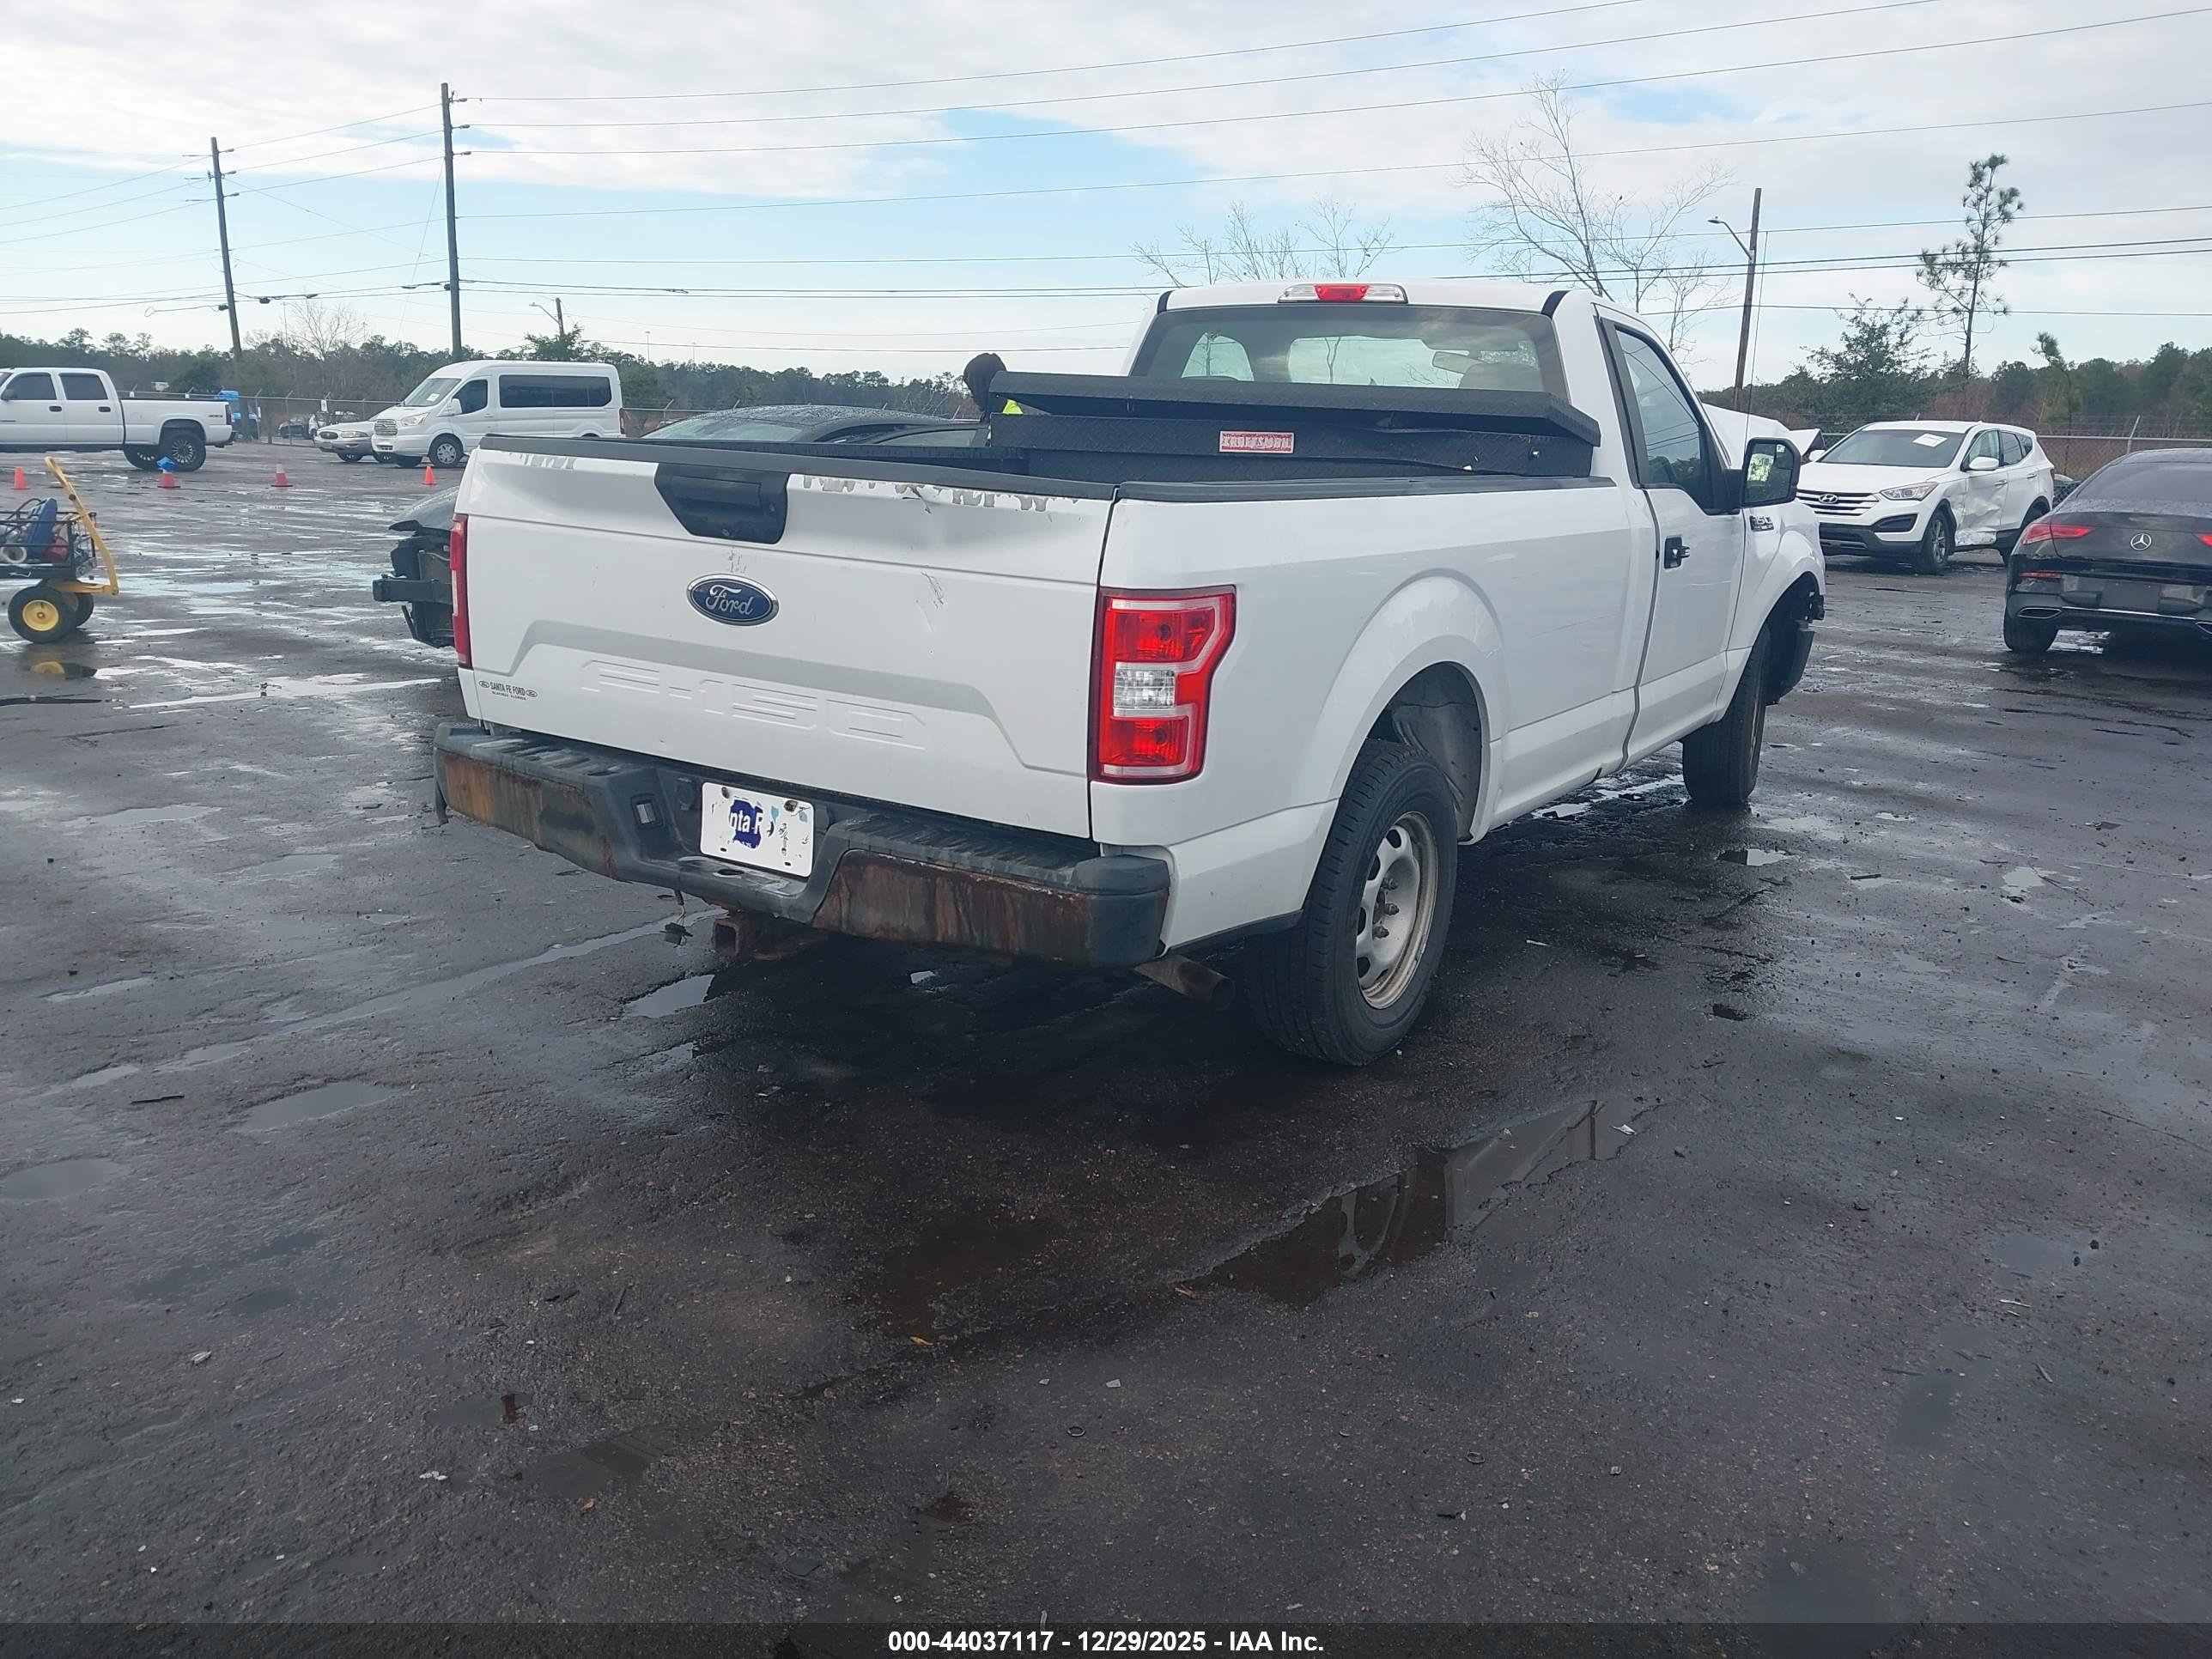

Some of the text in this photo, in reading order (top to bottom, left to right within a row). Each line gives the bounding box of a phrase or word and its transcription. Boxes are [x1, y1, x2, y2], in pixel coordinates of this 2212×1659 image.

[705, 584, 755, 616] Ford
[489, 681, 506, 693] SANTA
[505, 684, 513, 695] FE
[512, 685, 526, 696] FORD
